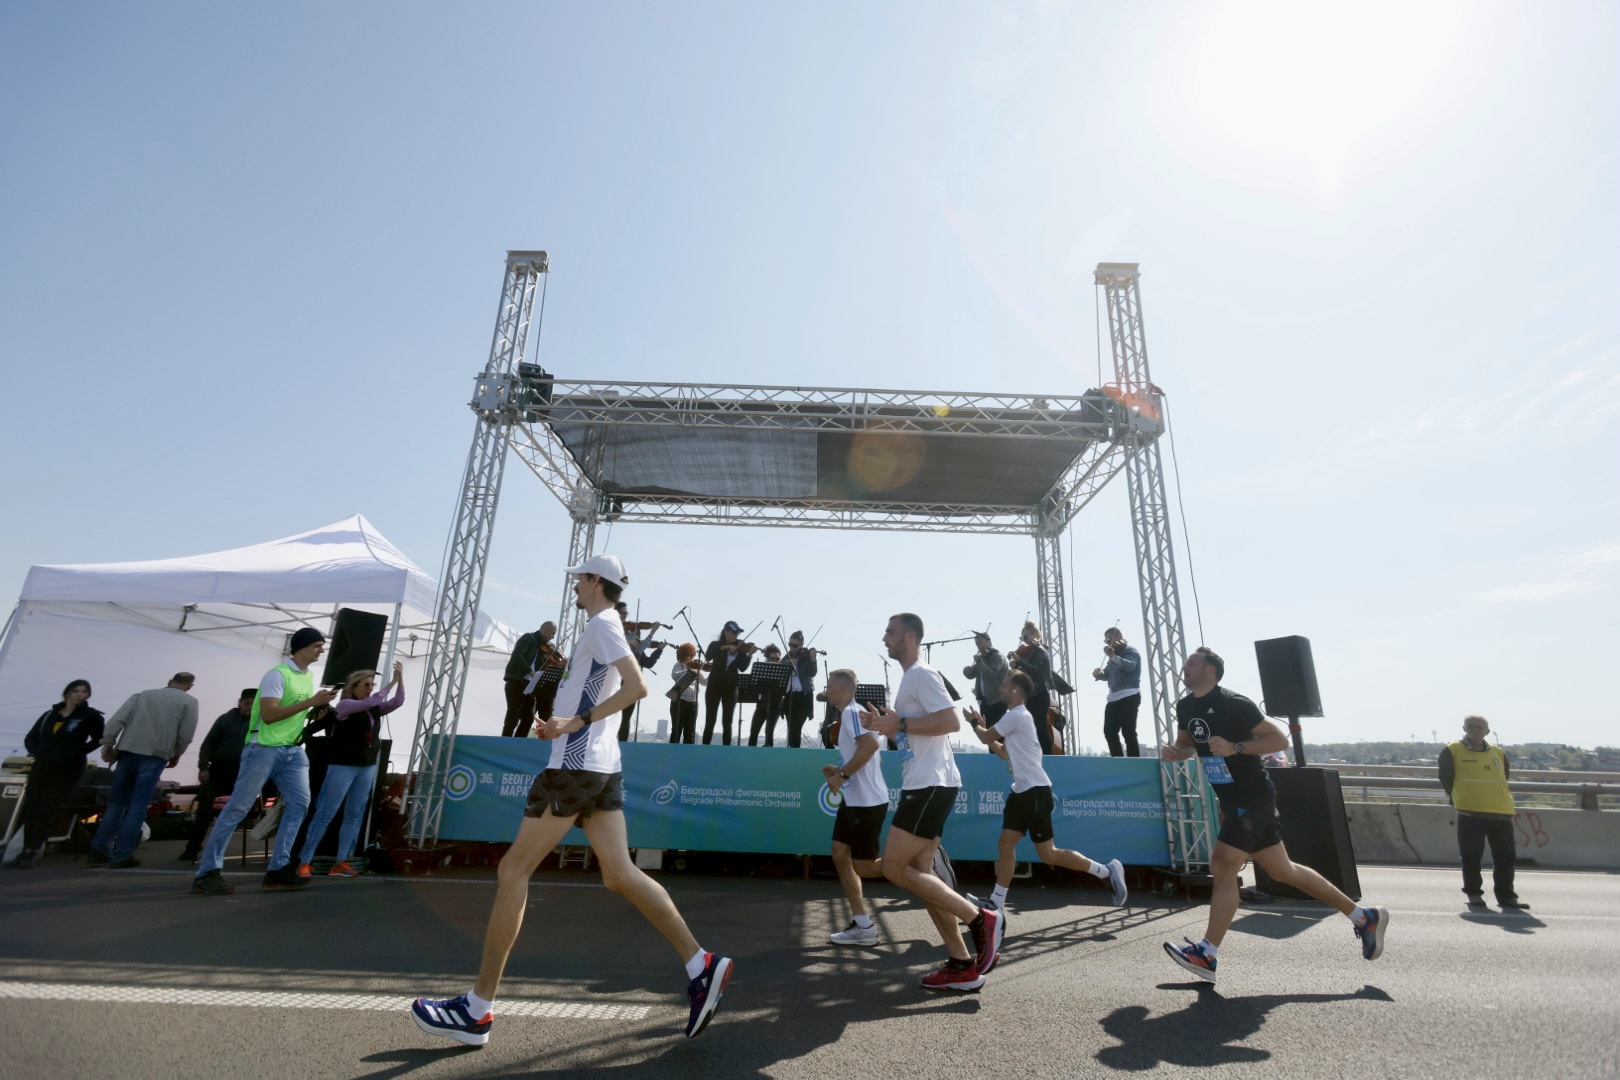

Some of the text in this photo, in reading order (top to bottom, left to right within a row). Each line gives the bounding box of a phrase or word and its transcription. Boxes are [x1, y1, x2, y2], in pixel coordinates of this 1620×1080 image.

[480, 773, 494, 784] 36.
[681, 785, 801, 801] Београдска филхармонија
[979, 791, 1005, 803] УВЕК
[680, 796, 801, 808] Belgrade Philharmonic Orchestra
[1062, 798, 1116, 809] Београдска
[954, 803, 968, 814] 23
[1062, 808, 1097, 818] Belgrade
